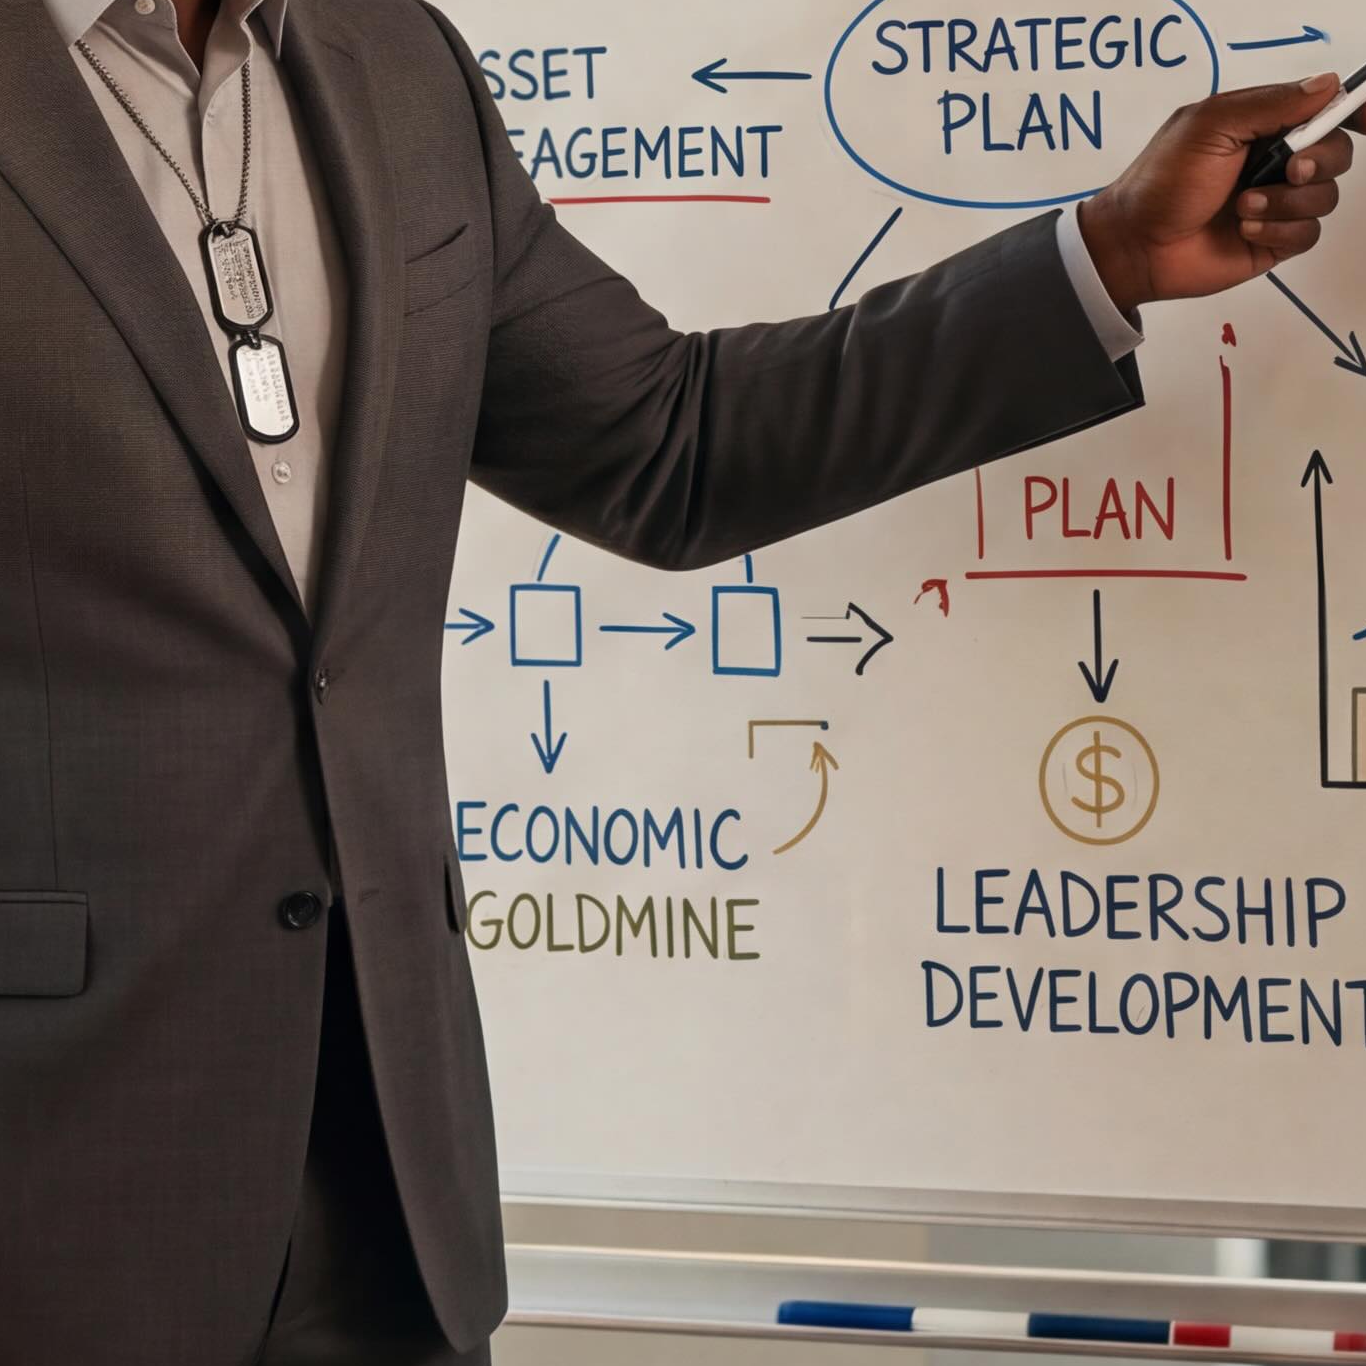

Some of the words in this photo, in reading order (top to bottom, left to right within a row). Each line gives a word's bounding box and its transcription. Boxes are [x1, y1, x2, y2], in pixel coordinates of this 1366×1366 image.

[872, 13, 1188, 76] STRATEGIC
[937, 89, 1102, 155] PLAN
[1024, 475, 1175, 541] PLAN
[457, 801, 749, 871] ECONOMIC
[466, 890, 761, 961] GOLDMINE
[936, 866, 1346, 949] LEADERSHIP
